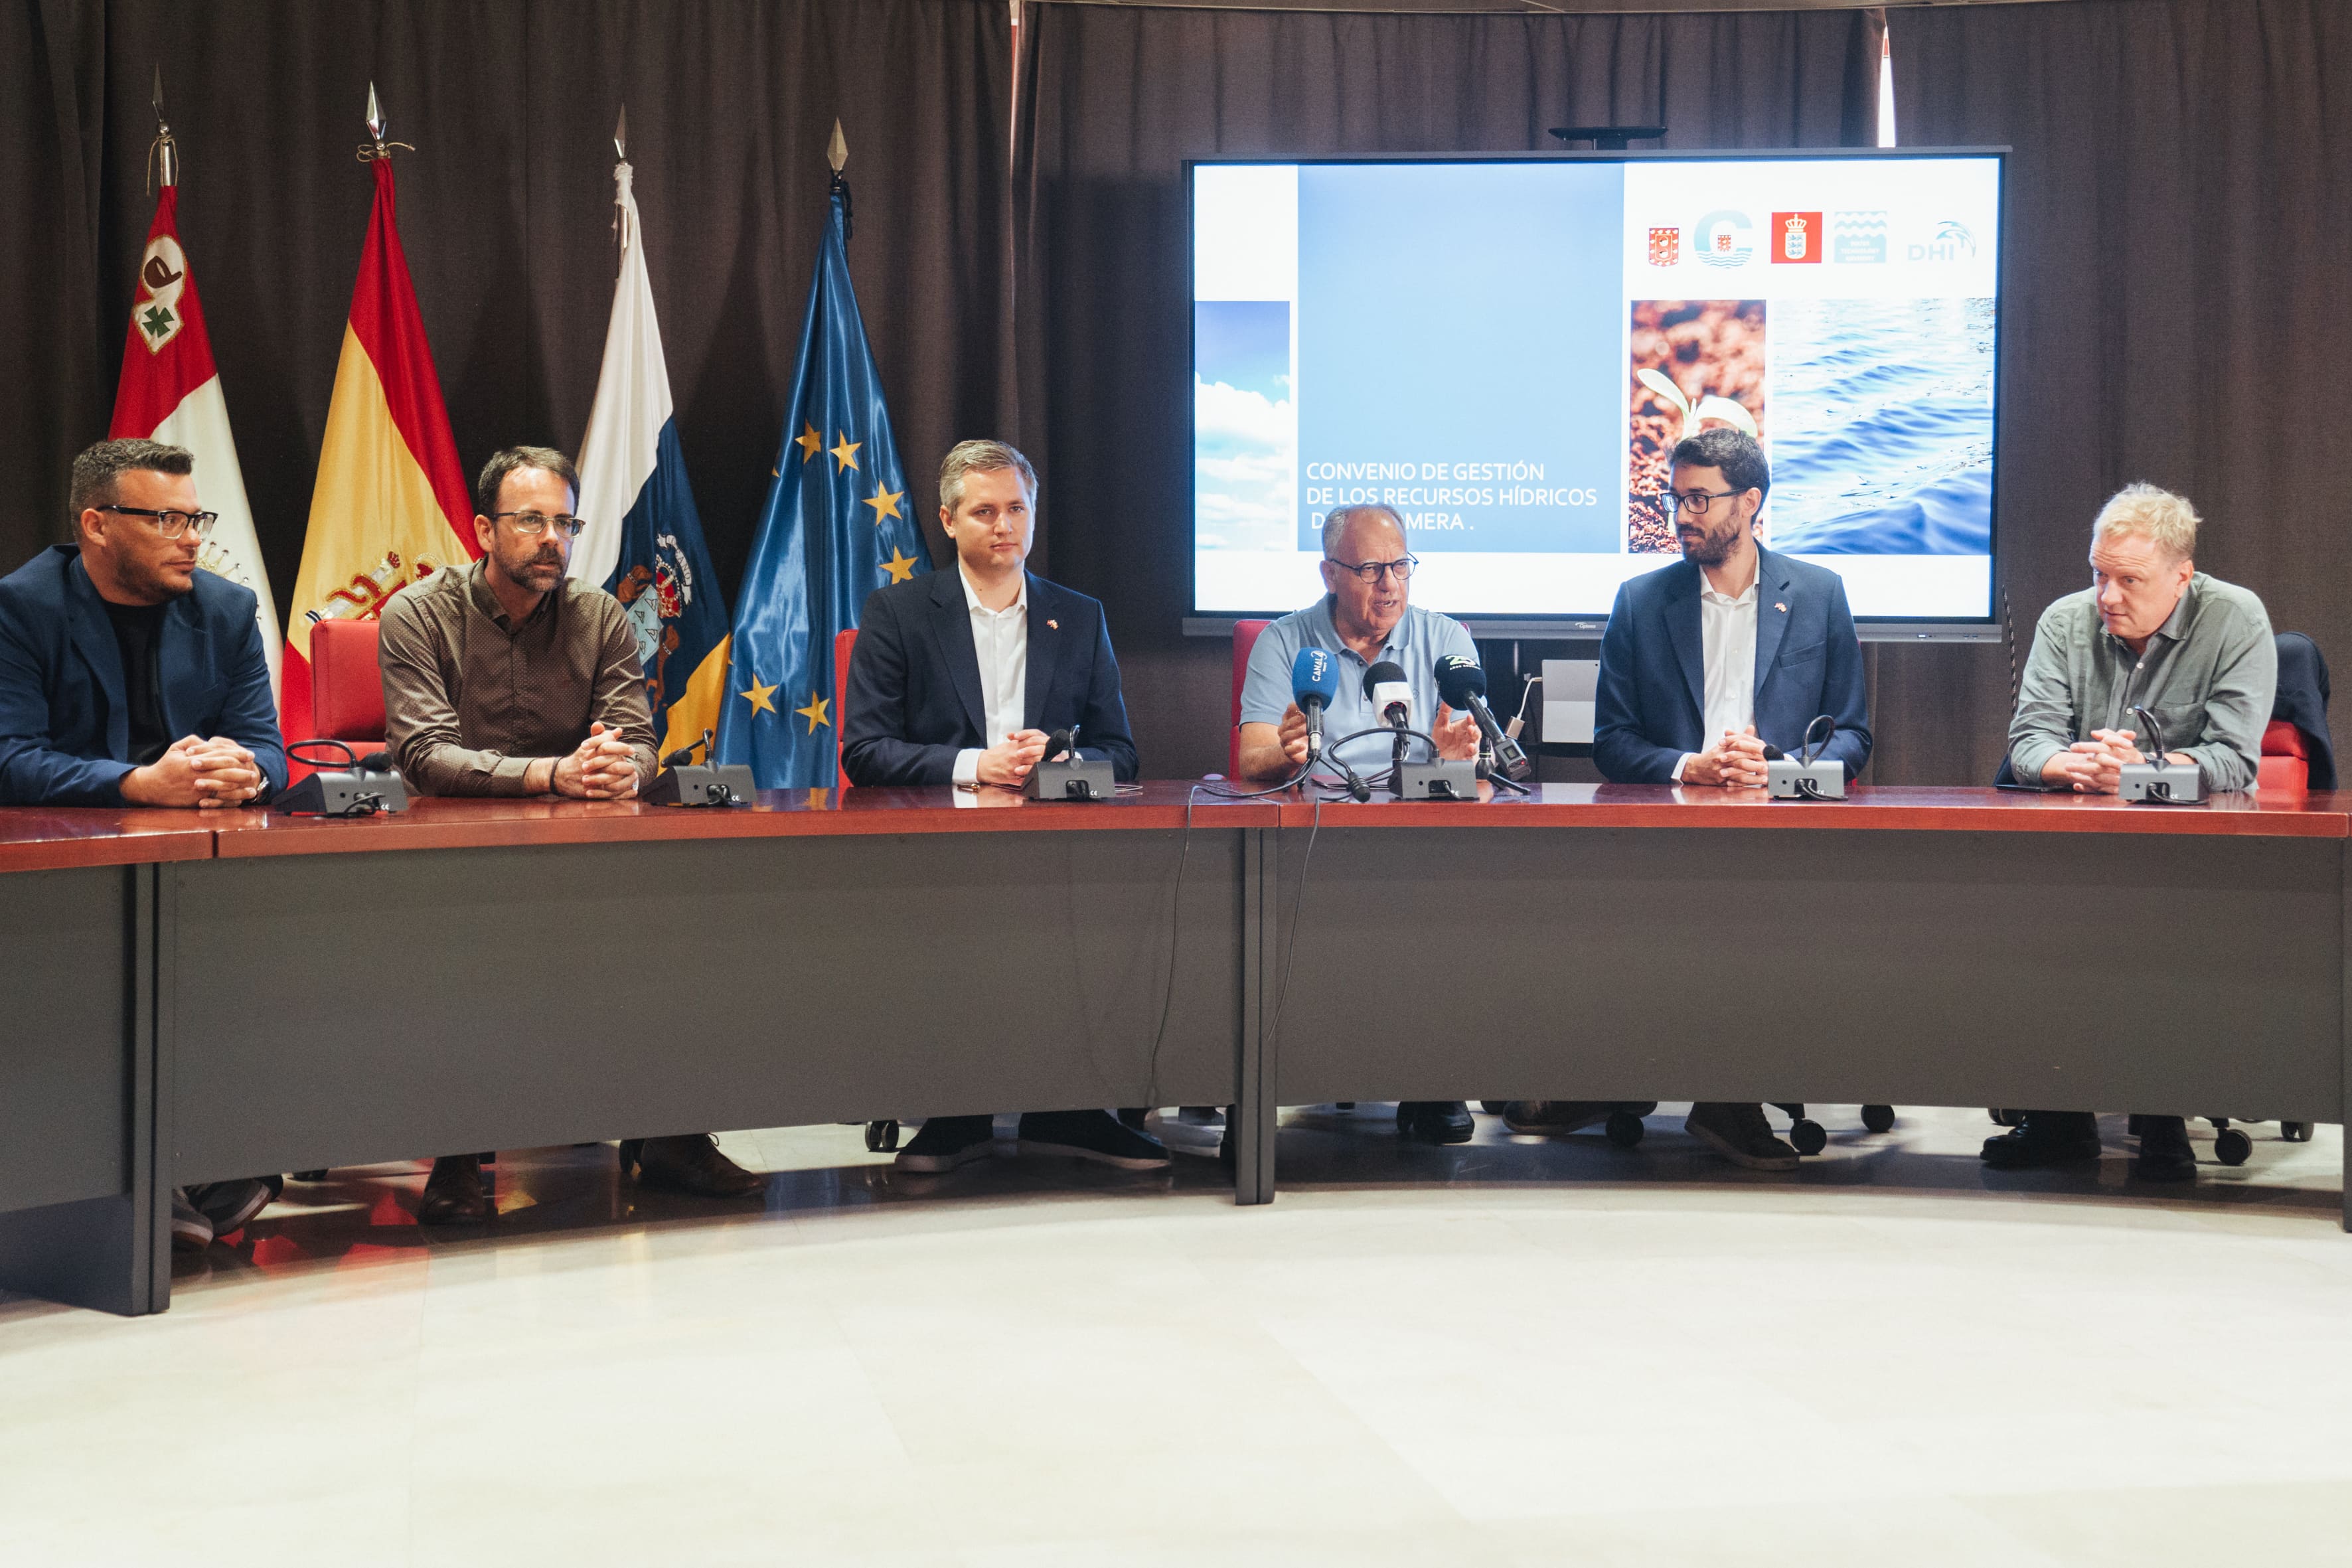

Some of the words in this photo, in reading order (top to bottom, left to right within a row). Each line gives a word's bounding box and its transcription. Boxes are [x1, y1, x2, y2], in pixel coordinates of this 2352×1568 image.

[1907, 244, 1954, 261] DHI
[1306, 462, 1416, 481] CONVENIO
[1422, 463, 1448, 481] DE
[1453, 459, 1544, 481] GESTIÓN
[1306, 488, 1333, 505] DE
[1339, 488, 1378, 505] LOS
[1385, 489, 1493, 505] RECURSOS
[1499, 485, 1597, 506] HÍDRICOS
[1403, 512, 1464, 530] MERA
